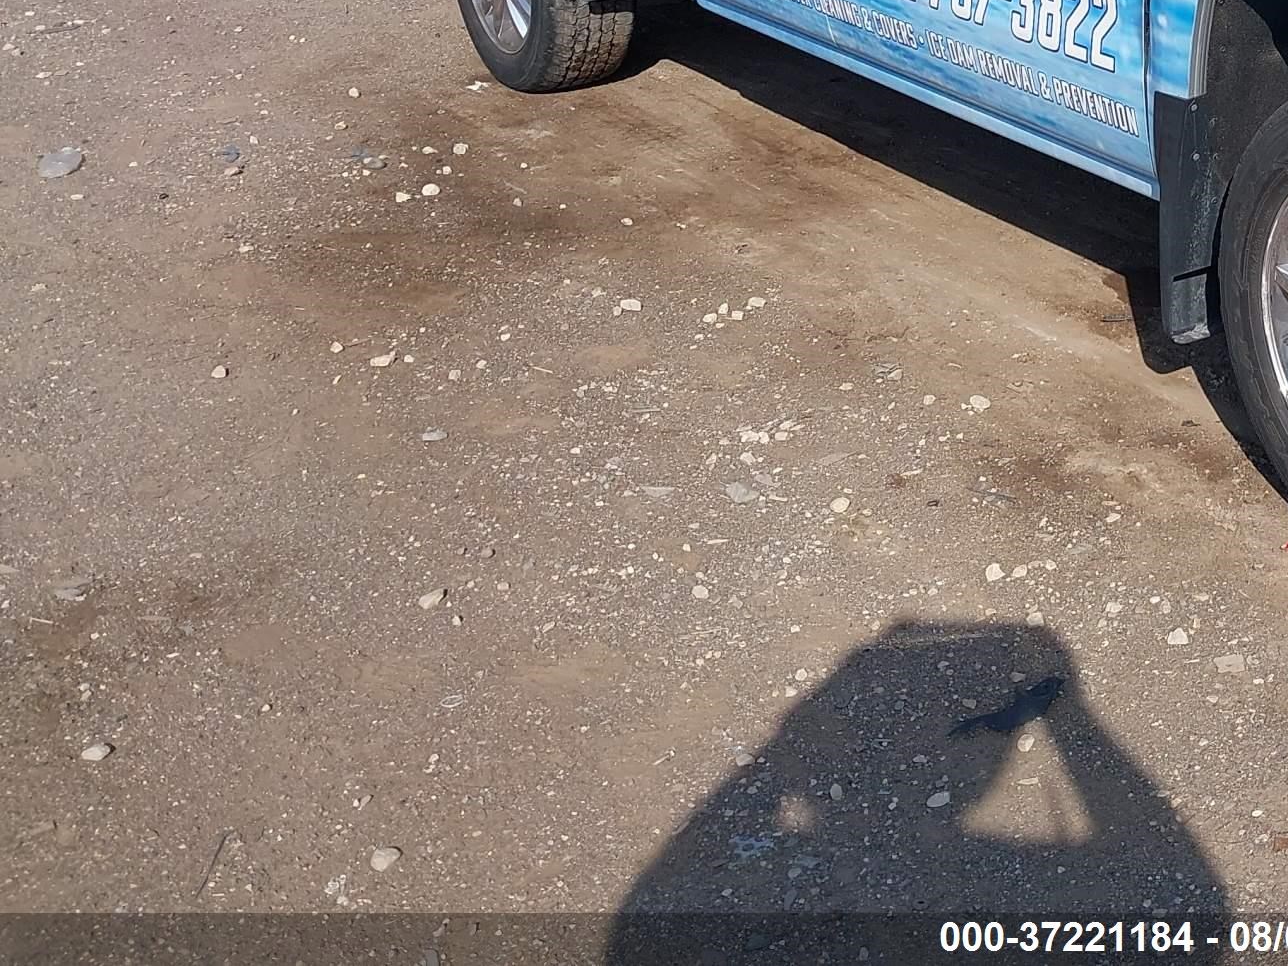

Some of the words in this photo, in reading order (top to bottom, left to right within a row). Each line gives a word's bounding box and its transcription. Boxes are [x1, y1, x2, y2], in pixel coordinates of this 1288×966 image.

[871, 9, 919, 50] COVERS
[925, 31, 948, 61] ICE
[946, 37, 978, 74] DAM
[976, 49, 1040, 97] REMOVAL
[1051, 76, 1140, 138] PREVENTION
